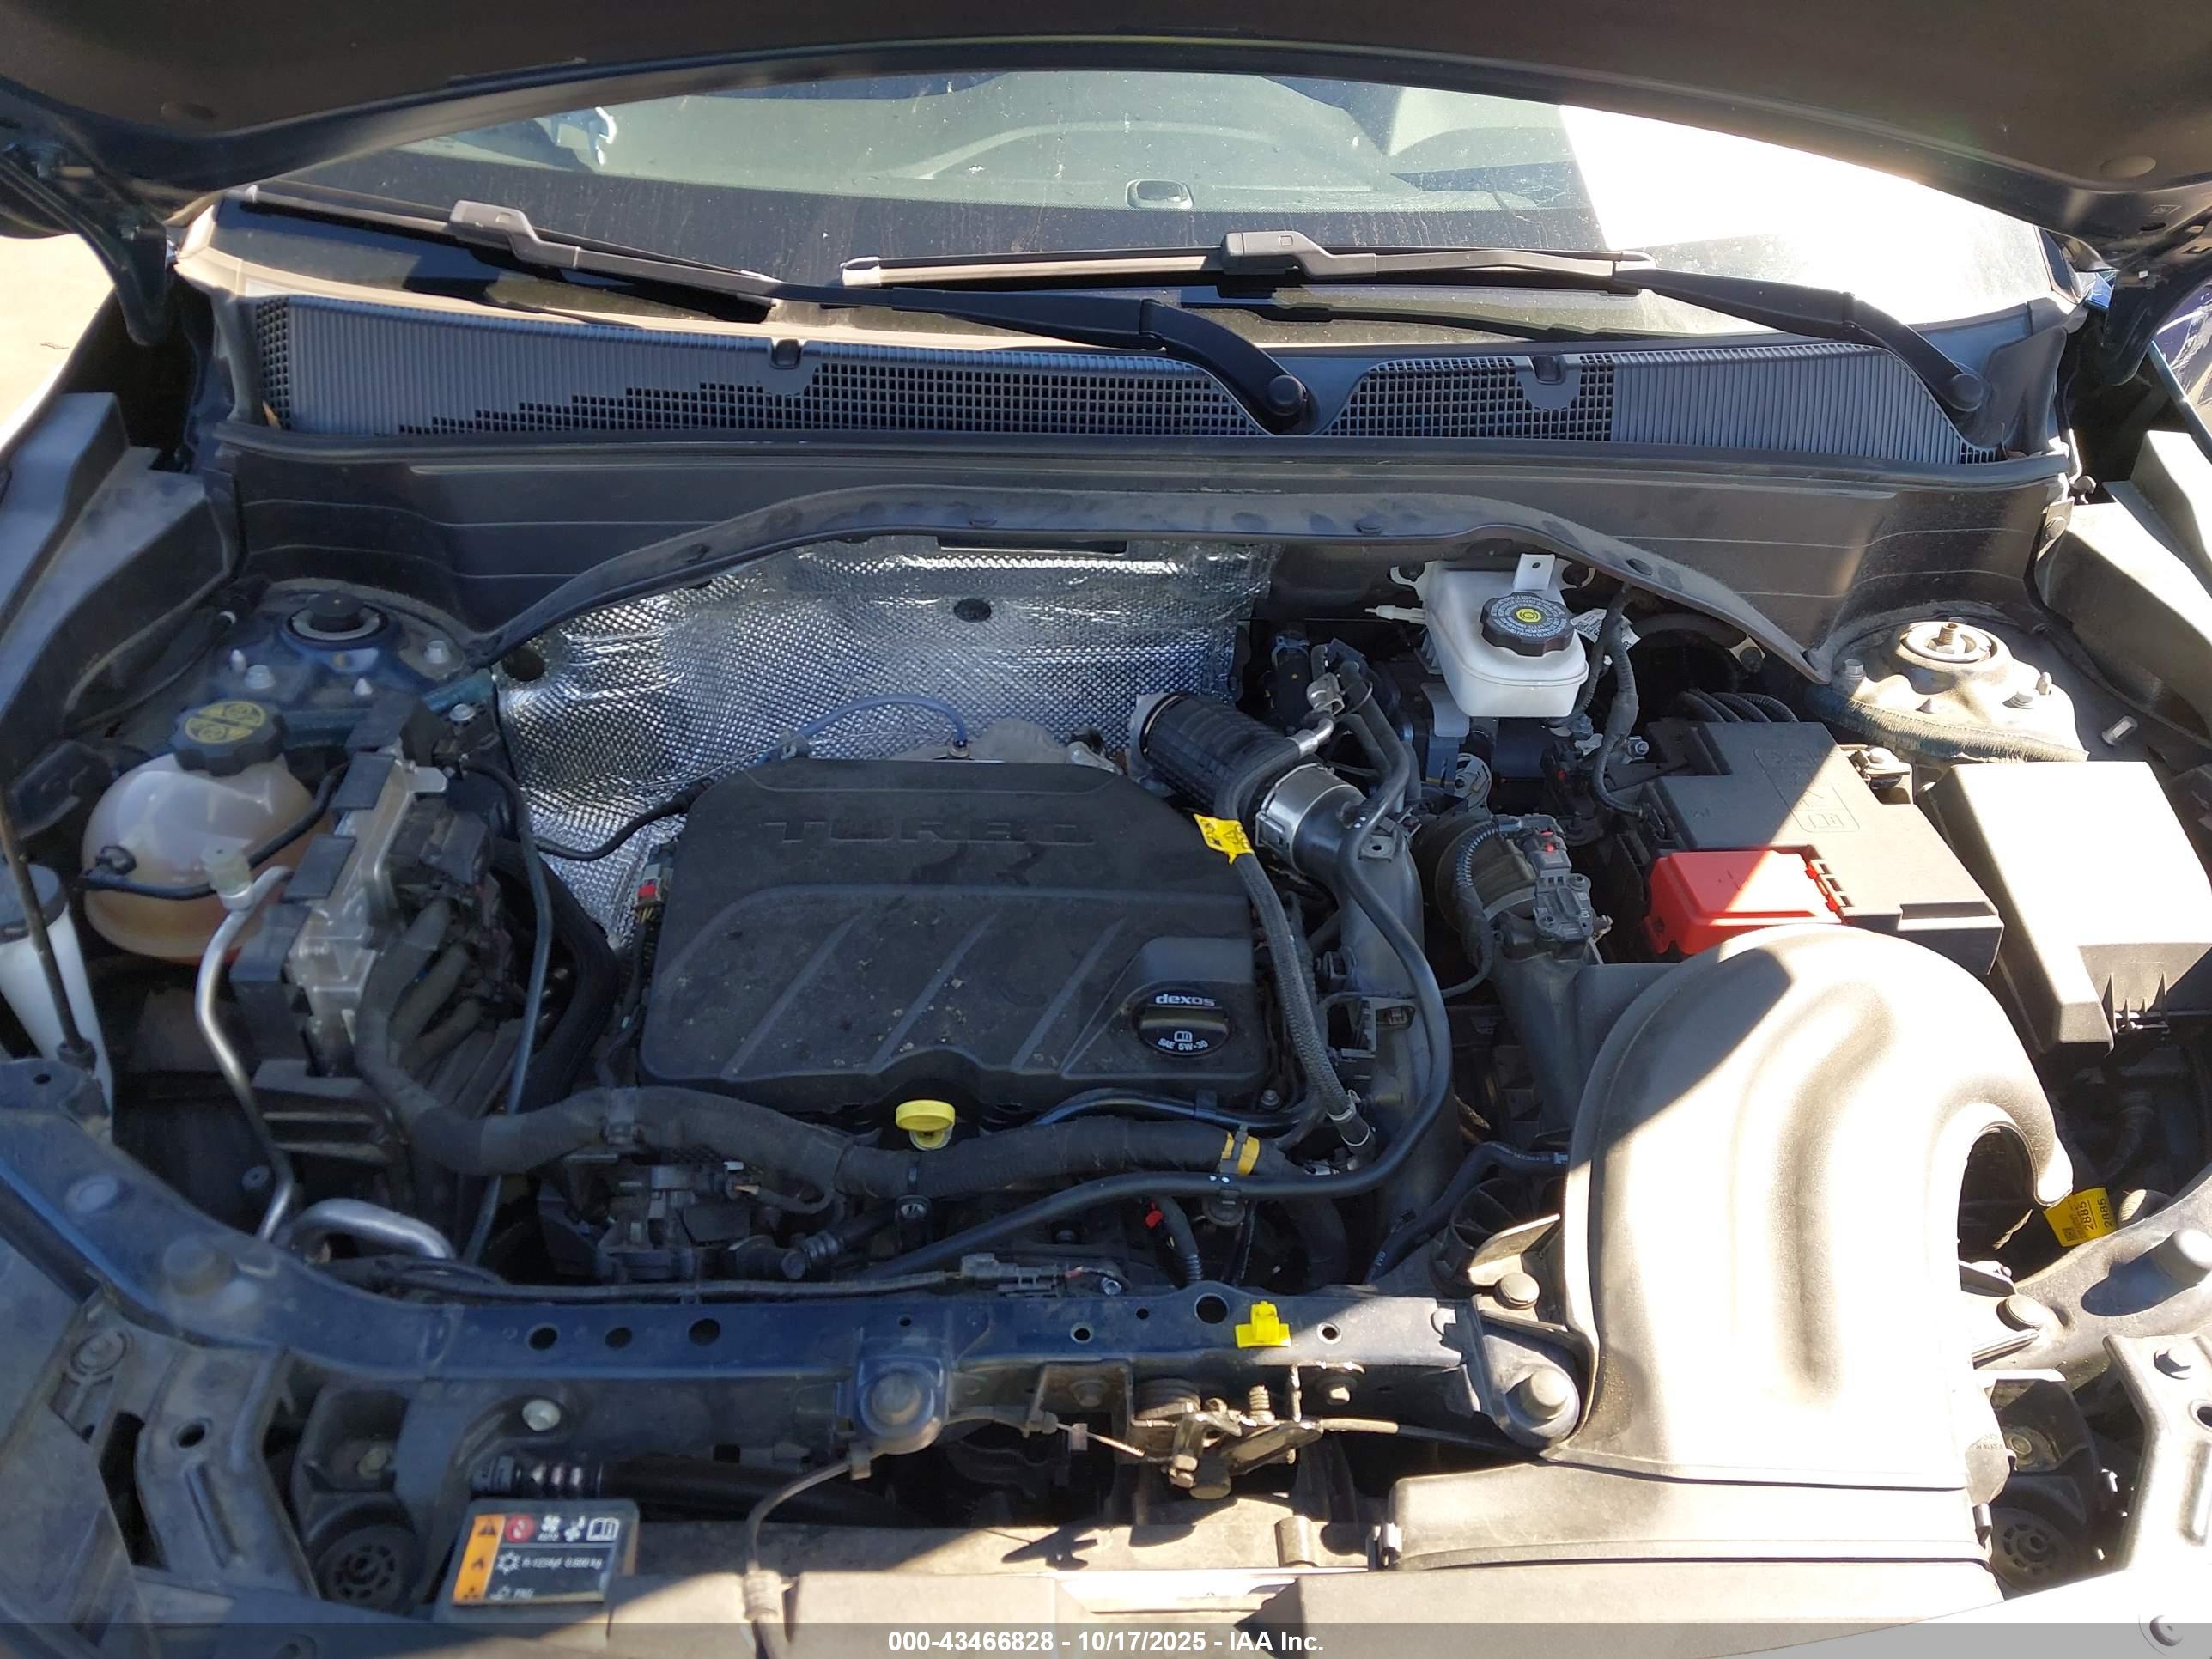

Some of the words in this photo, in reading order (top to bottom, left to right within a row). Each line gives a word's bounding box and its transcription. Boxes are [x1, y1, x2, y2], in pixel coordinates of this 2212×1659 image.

[763, 820, 1097, 846] TURBO
[1155, 993, 1217, 1007] dexos
[1157, 1037, 1176, 1049] SAE
[2079, 1201, 2094, 1231] 2885
